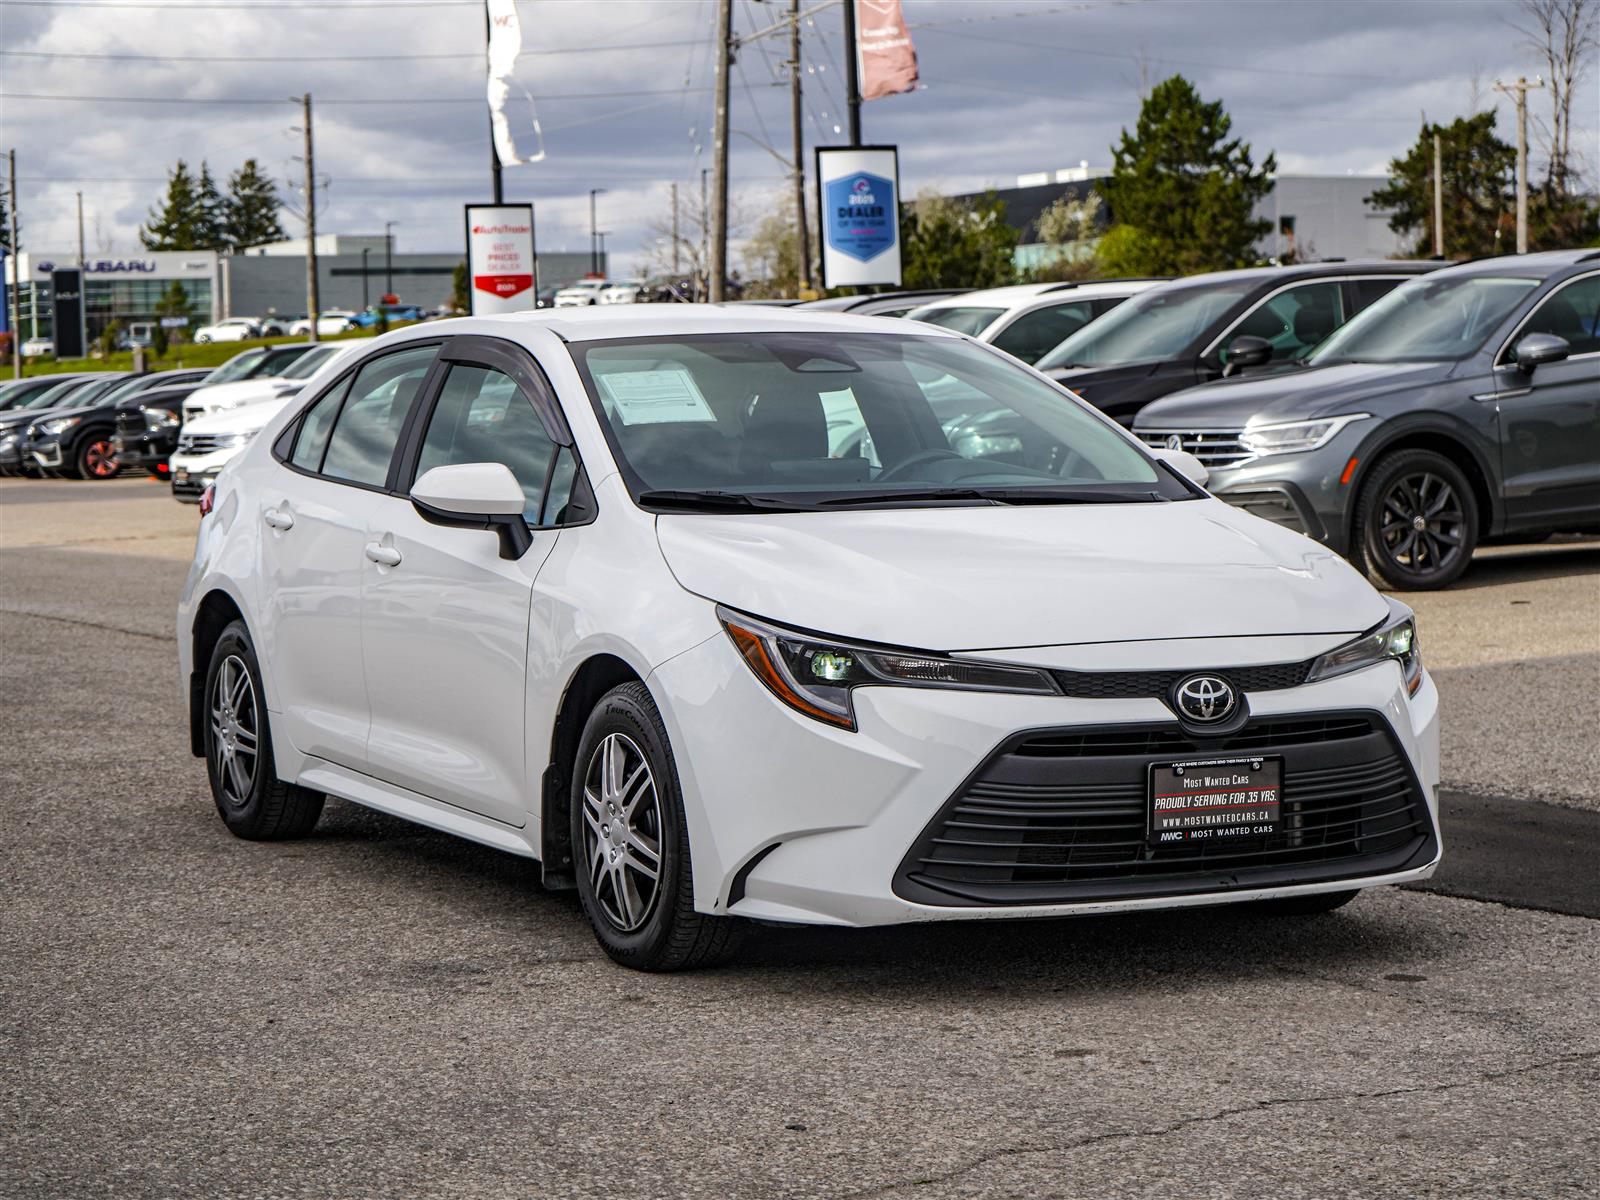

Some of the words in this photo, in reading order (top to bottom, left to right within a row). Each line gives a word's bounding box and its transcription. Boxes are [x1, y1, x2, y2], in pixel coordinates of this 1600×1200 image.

[837, 207, 884, 218] DEALER
[1183, 778, 1202, 788] MOST
[1204, 776, 1230, 787] WANTED
[1232, 774, 1249, 785] CARS
[1154, 796, 1193, 810] PROUDLY
[1193, 793, 1228, 808] SERVING
[1229, 792, 1245, 804] FOR
[1247, 791, 1258, 803] 35
[1260, 790, 1277, 802] YRS.
[1162, 811, 1269, 828] WWW.MOSTWANTEDCARS.CA
[1191, 829, 1213, 839] MOST
[1217, 826, 1250, 837] WANTED
[1253, 825, 1273, 834] CARS
